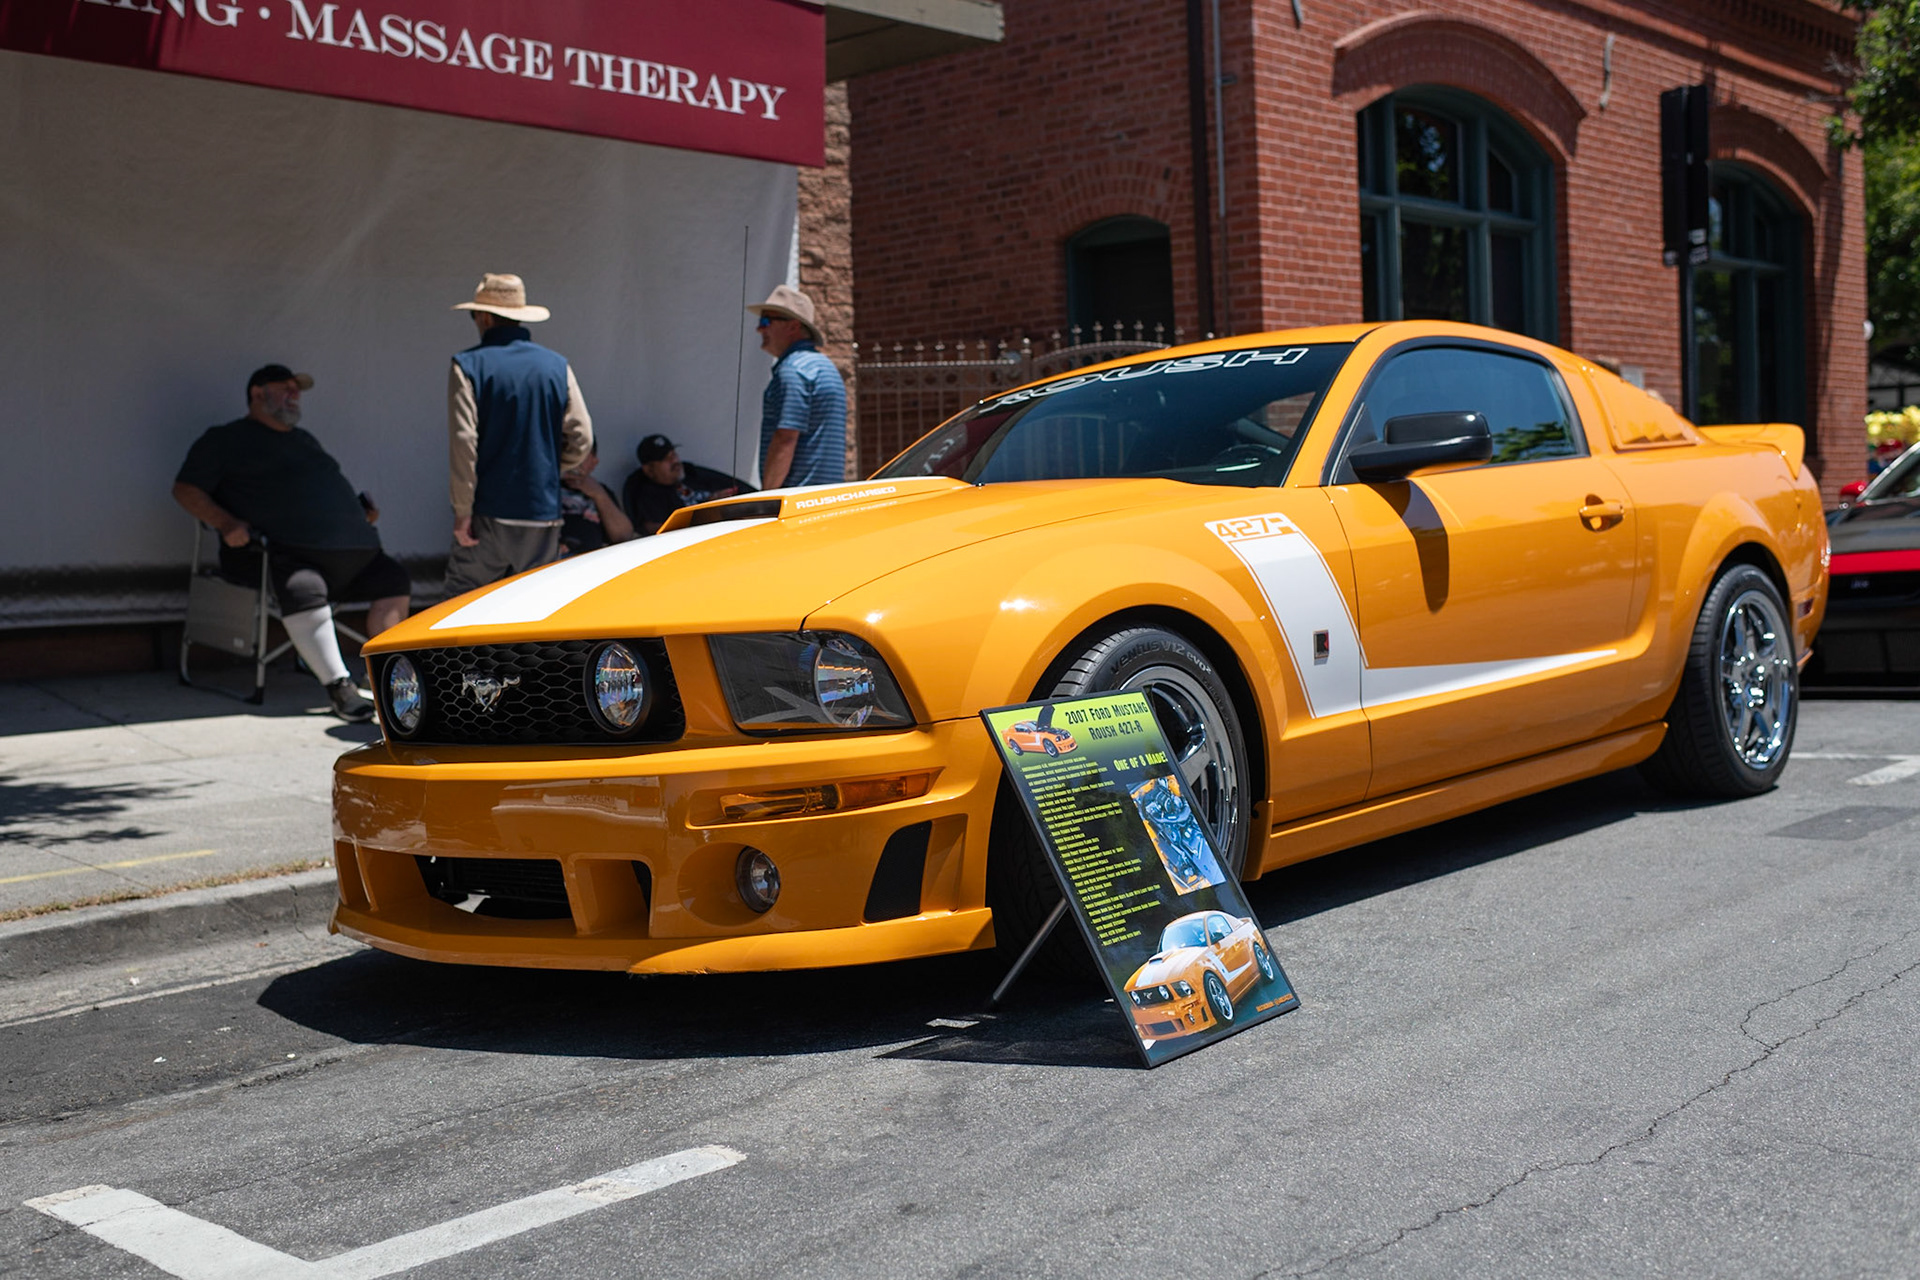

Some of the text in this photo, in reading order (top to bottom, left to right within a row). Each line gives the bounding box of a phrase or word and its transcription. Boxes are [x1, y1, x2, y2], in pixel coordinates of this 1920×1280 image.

[286, 0, 786, 121] MASSAGE THERAPY
[979, 348, 1309, 413] ROUSH
[796, 486, 897, 509] ROUSHCHARGED
[1065, 709, 1088, 725] 2007
[1118, 720, 1144, 737] 427-R
